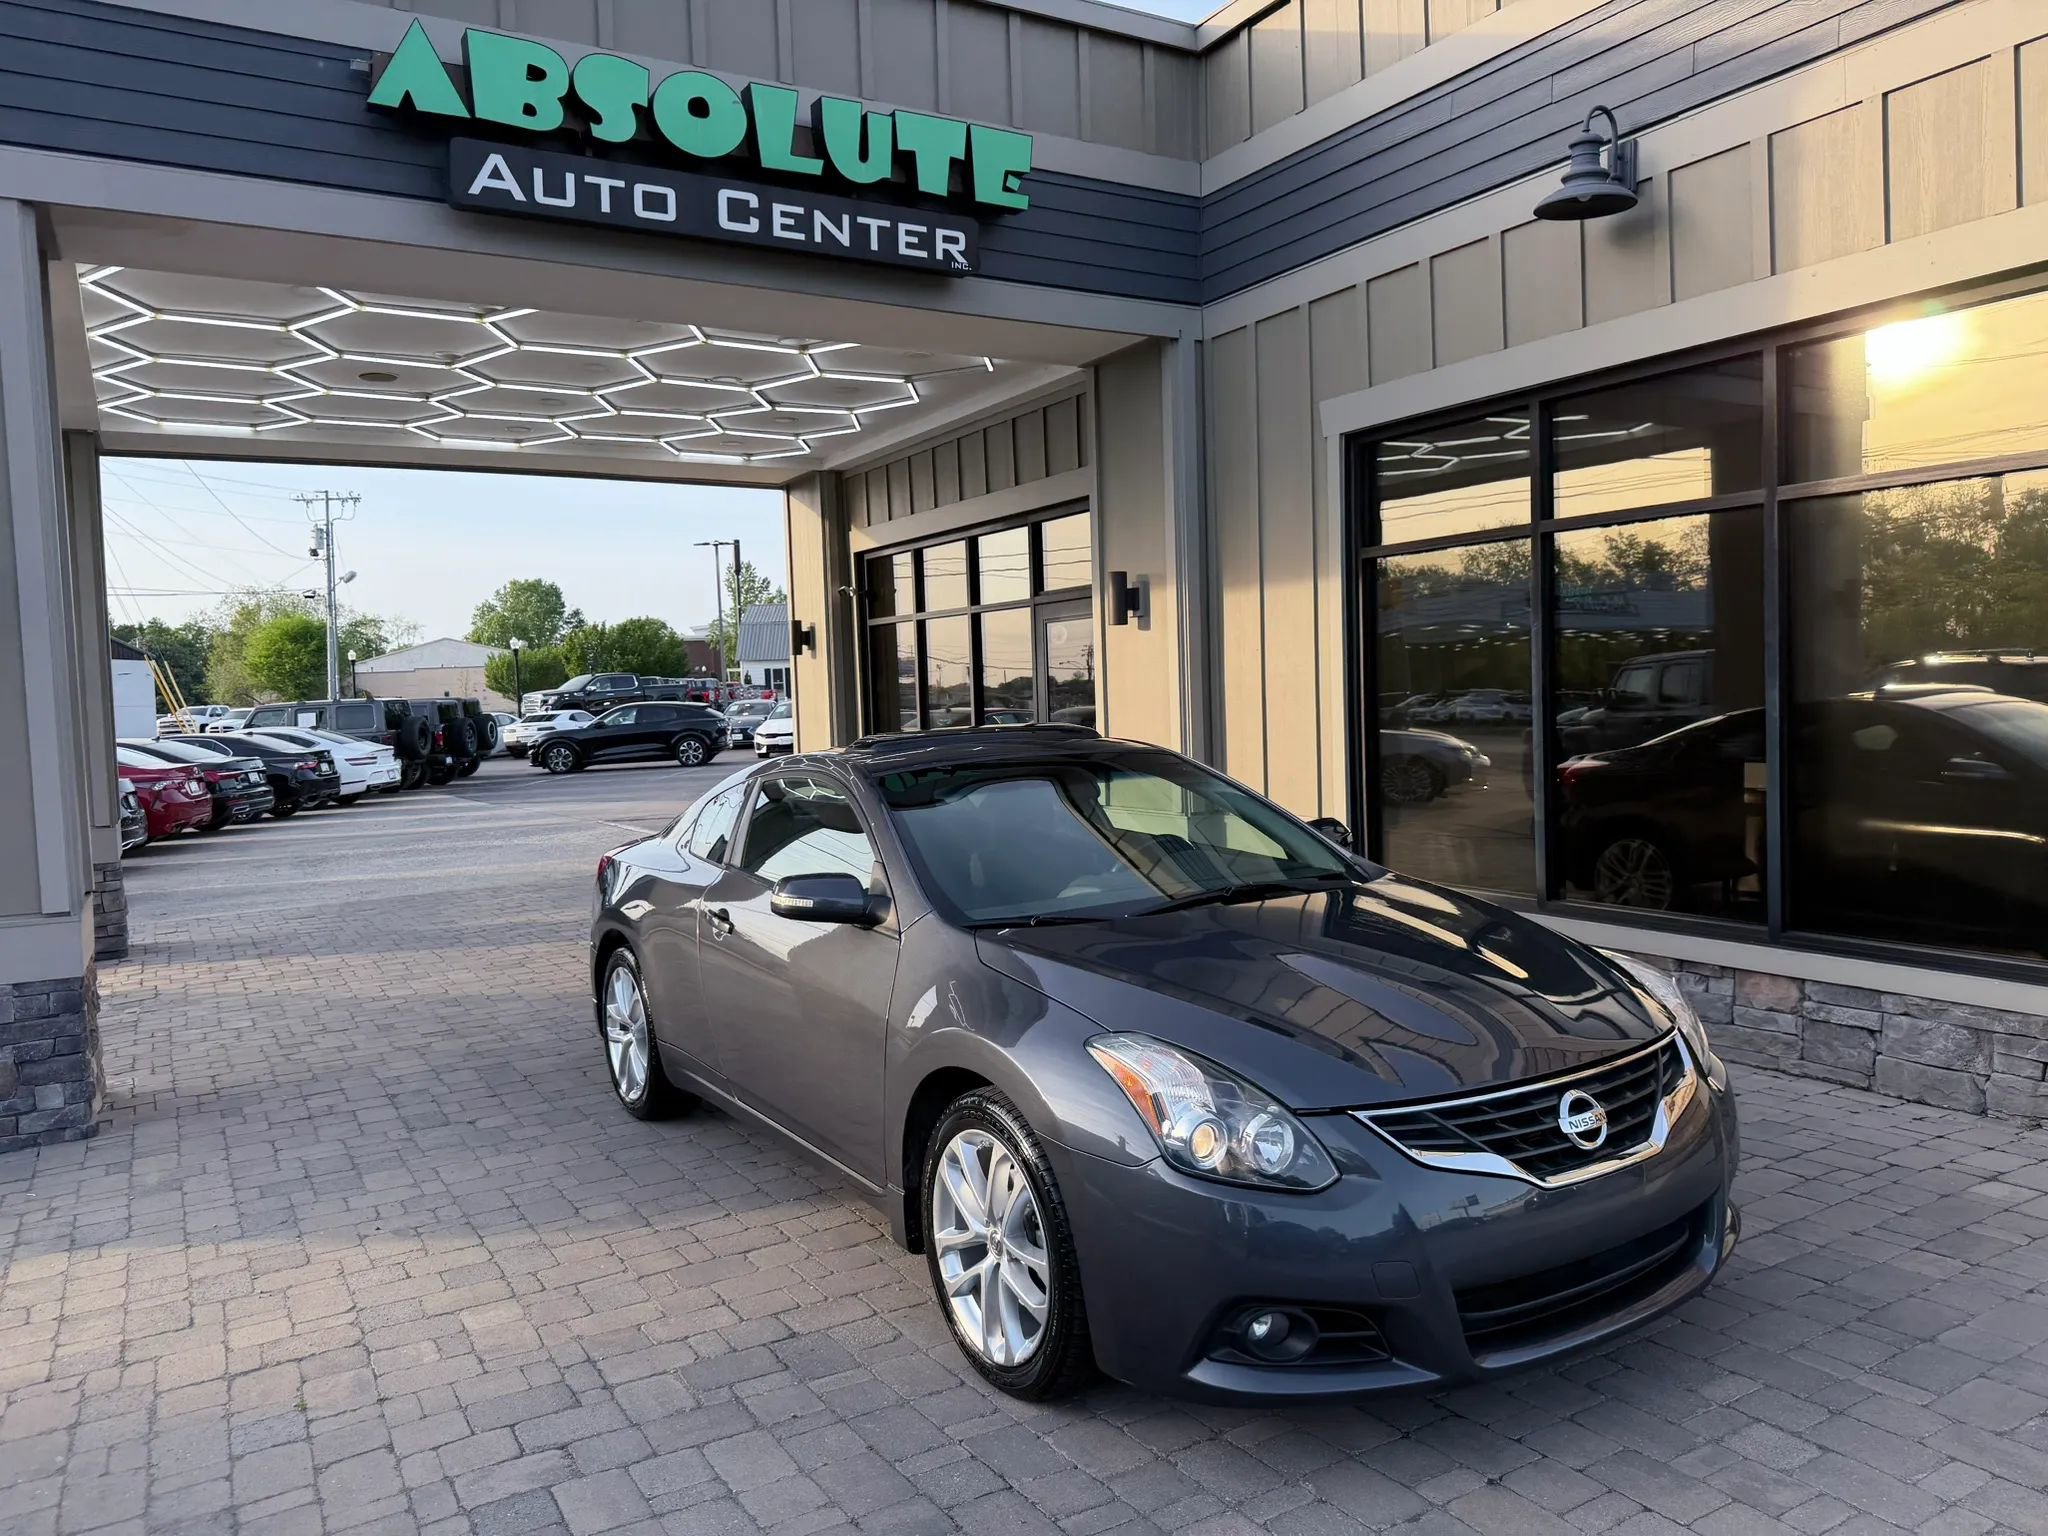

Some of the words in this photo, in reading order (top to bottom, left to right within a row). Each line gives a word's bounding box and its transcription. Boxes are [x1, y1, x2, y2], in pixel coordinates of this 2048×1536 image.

[367, 17, 1031, 210] ABSOLUTE
[468, 153, 678, 222] AUTO
[717, 189, 968, 263] CENTER
[951, 261, 972, 271] INC.
[1568, 1112, 1606, 1130] NISSAN
